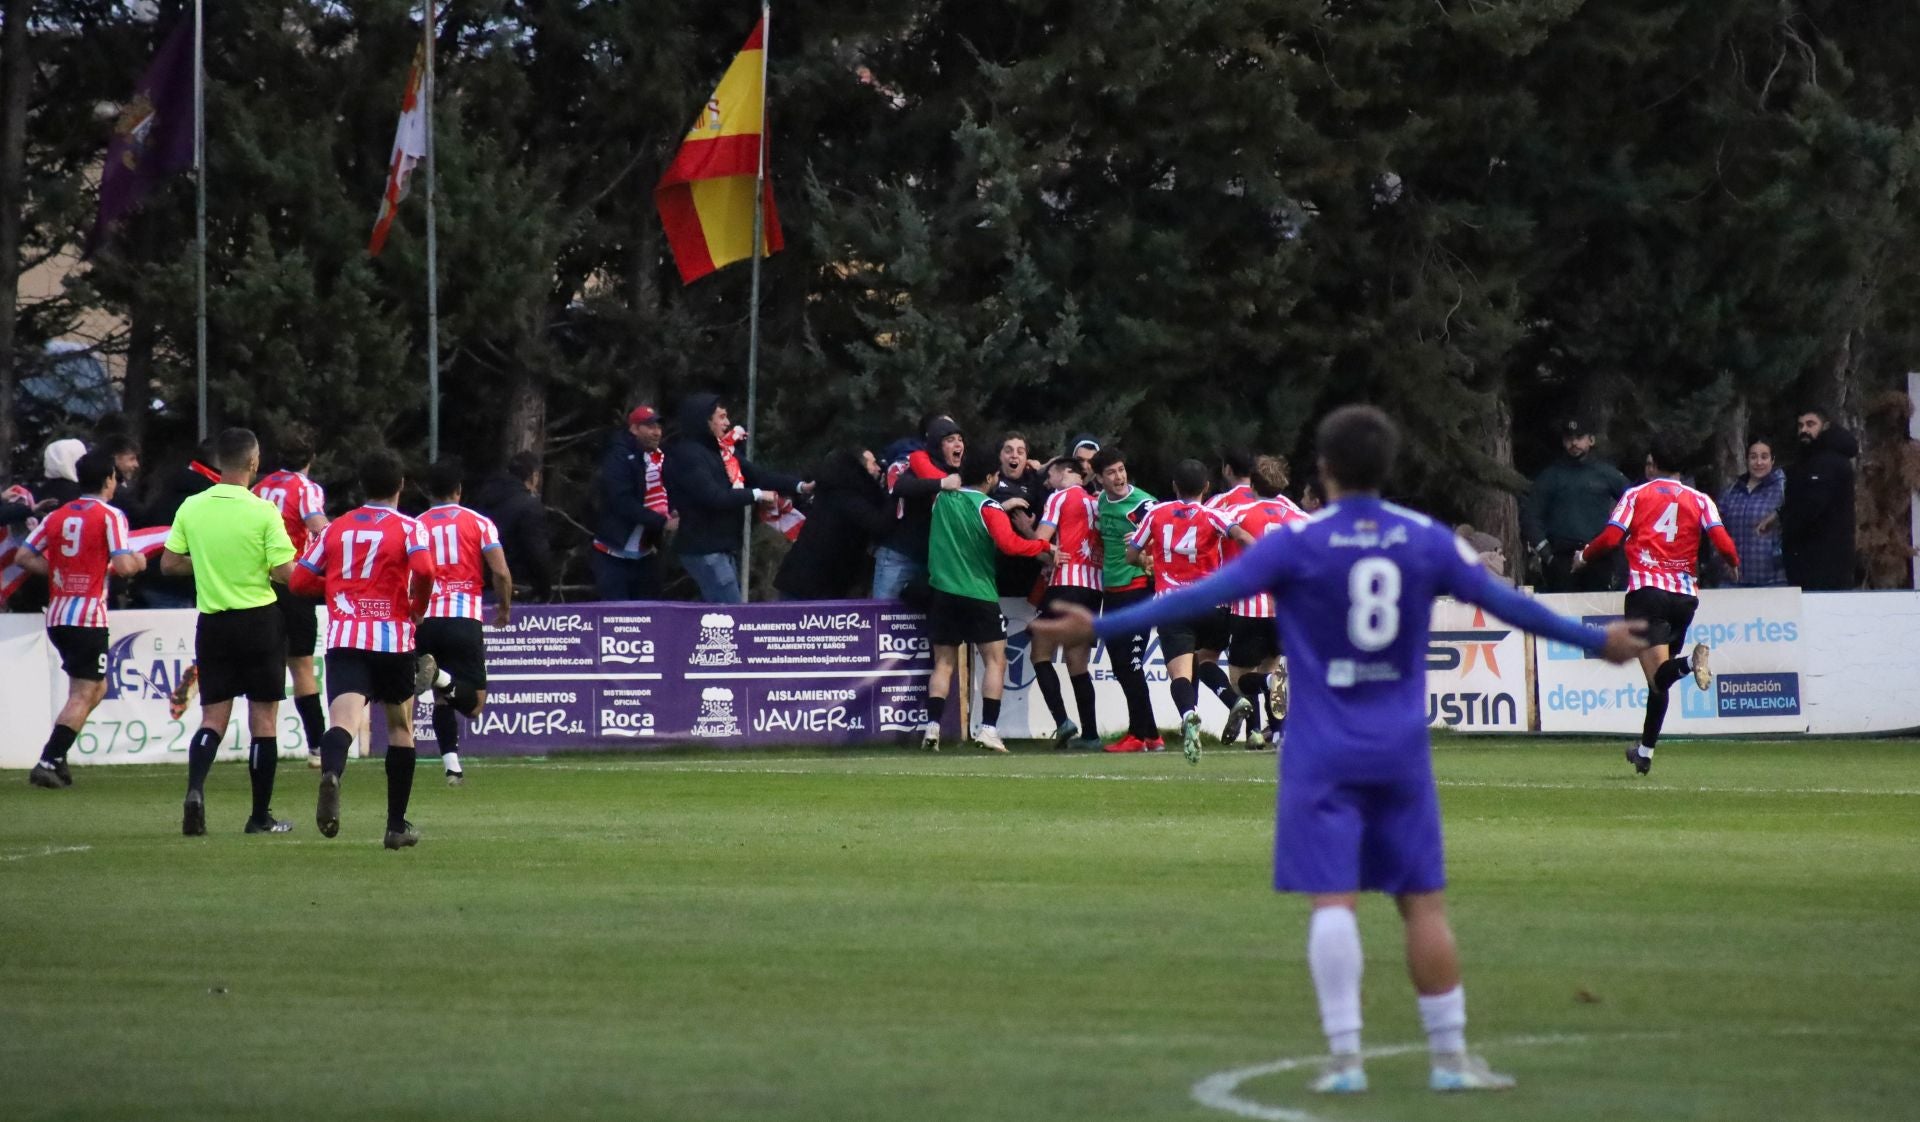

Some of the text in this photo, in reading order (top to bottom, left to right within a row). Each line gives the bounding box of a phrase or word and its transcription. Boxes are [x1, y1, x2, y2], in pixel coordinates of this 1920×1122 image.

[1653, 502, 1679, 543] 4
[61, 516, 83, 560] 9
[432, 524, 459, 566] 11
[1162, 523, 1198, 564] 14
[341, 529, 384, 579] 17
[358, 601, 391, 609] ULCES
[1347, 556, 1402, 652] 8
[603, 616, 652, 624] DISTRIBUIDOR
[738, 622, 797, 631] AISLAMIENTOS
[483, 637, 515, 645] TERIALES
[601, 636, 655, 654] Roca
[807, 635, 859, 643] CONSTRUCCIÓN
[823, 642, 846, 650] BAÑOS
[879, 634, 930, 651] Roca
[98, 653, 108, 674] 9
[747, 655, 871, 665] www.aislamientosjavier.com
[603, 689, 652, 697] DISTRIBUIDOR
[881, 685, 927, 693] DISTRIBUIDOR
[1720, 680, 1782, 695] Diputación
[485, 692, 577, 704] AISLAMIENTOS
[766, 690, 856, 701] AISLAMIENTOS
[1547, 682, 1648, 715] deporte
[1721, 696, 1797, 710] DE PALENCIA
[601, 709, 655, 727] Roca
[879, 705, 929, 723] Roca
